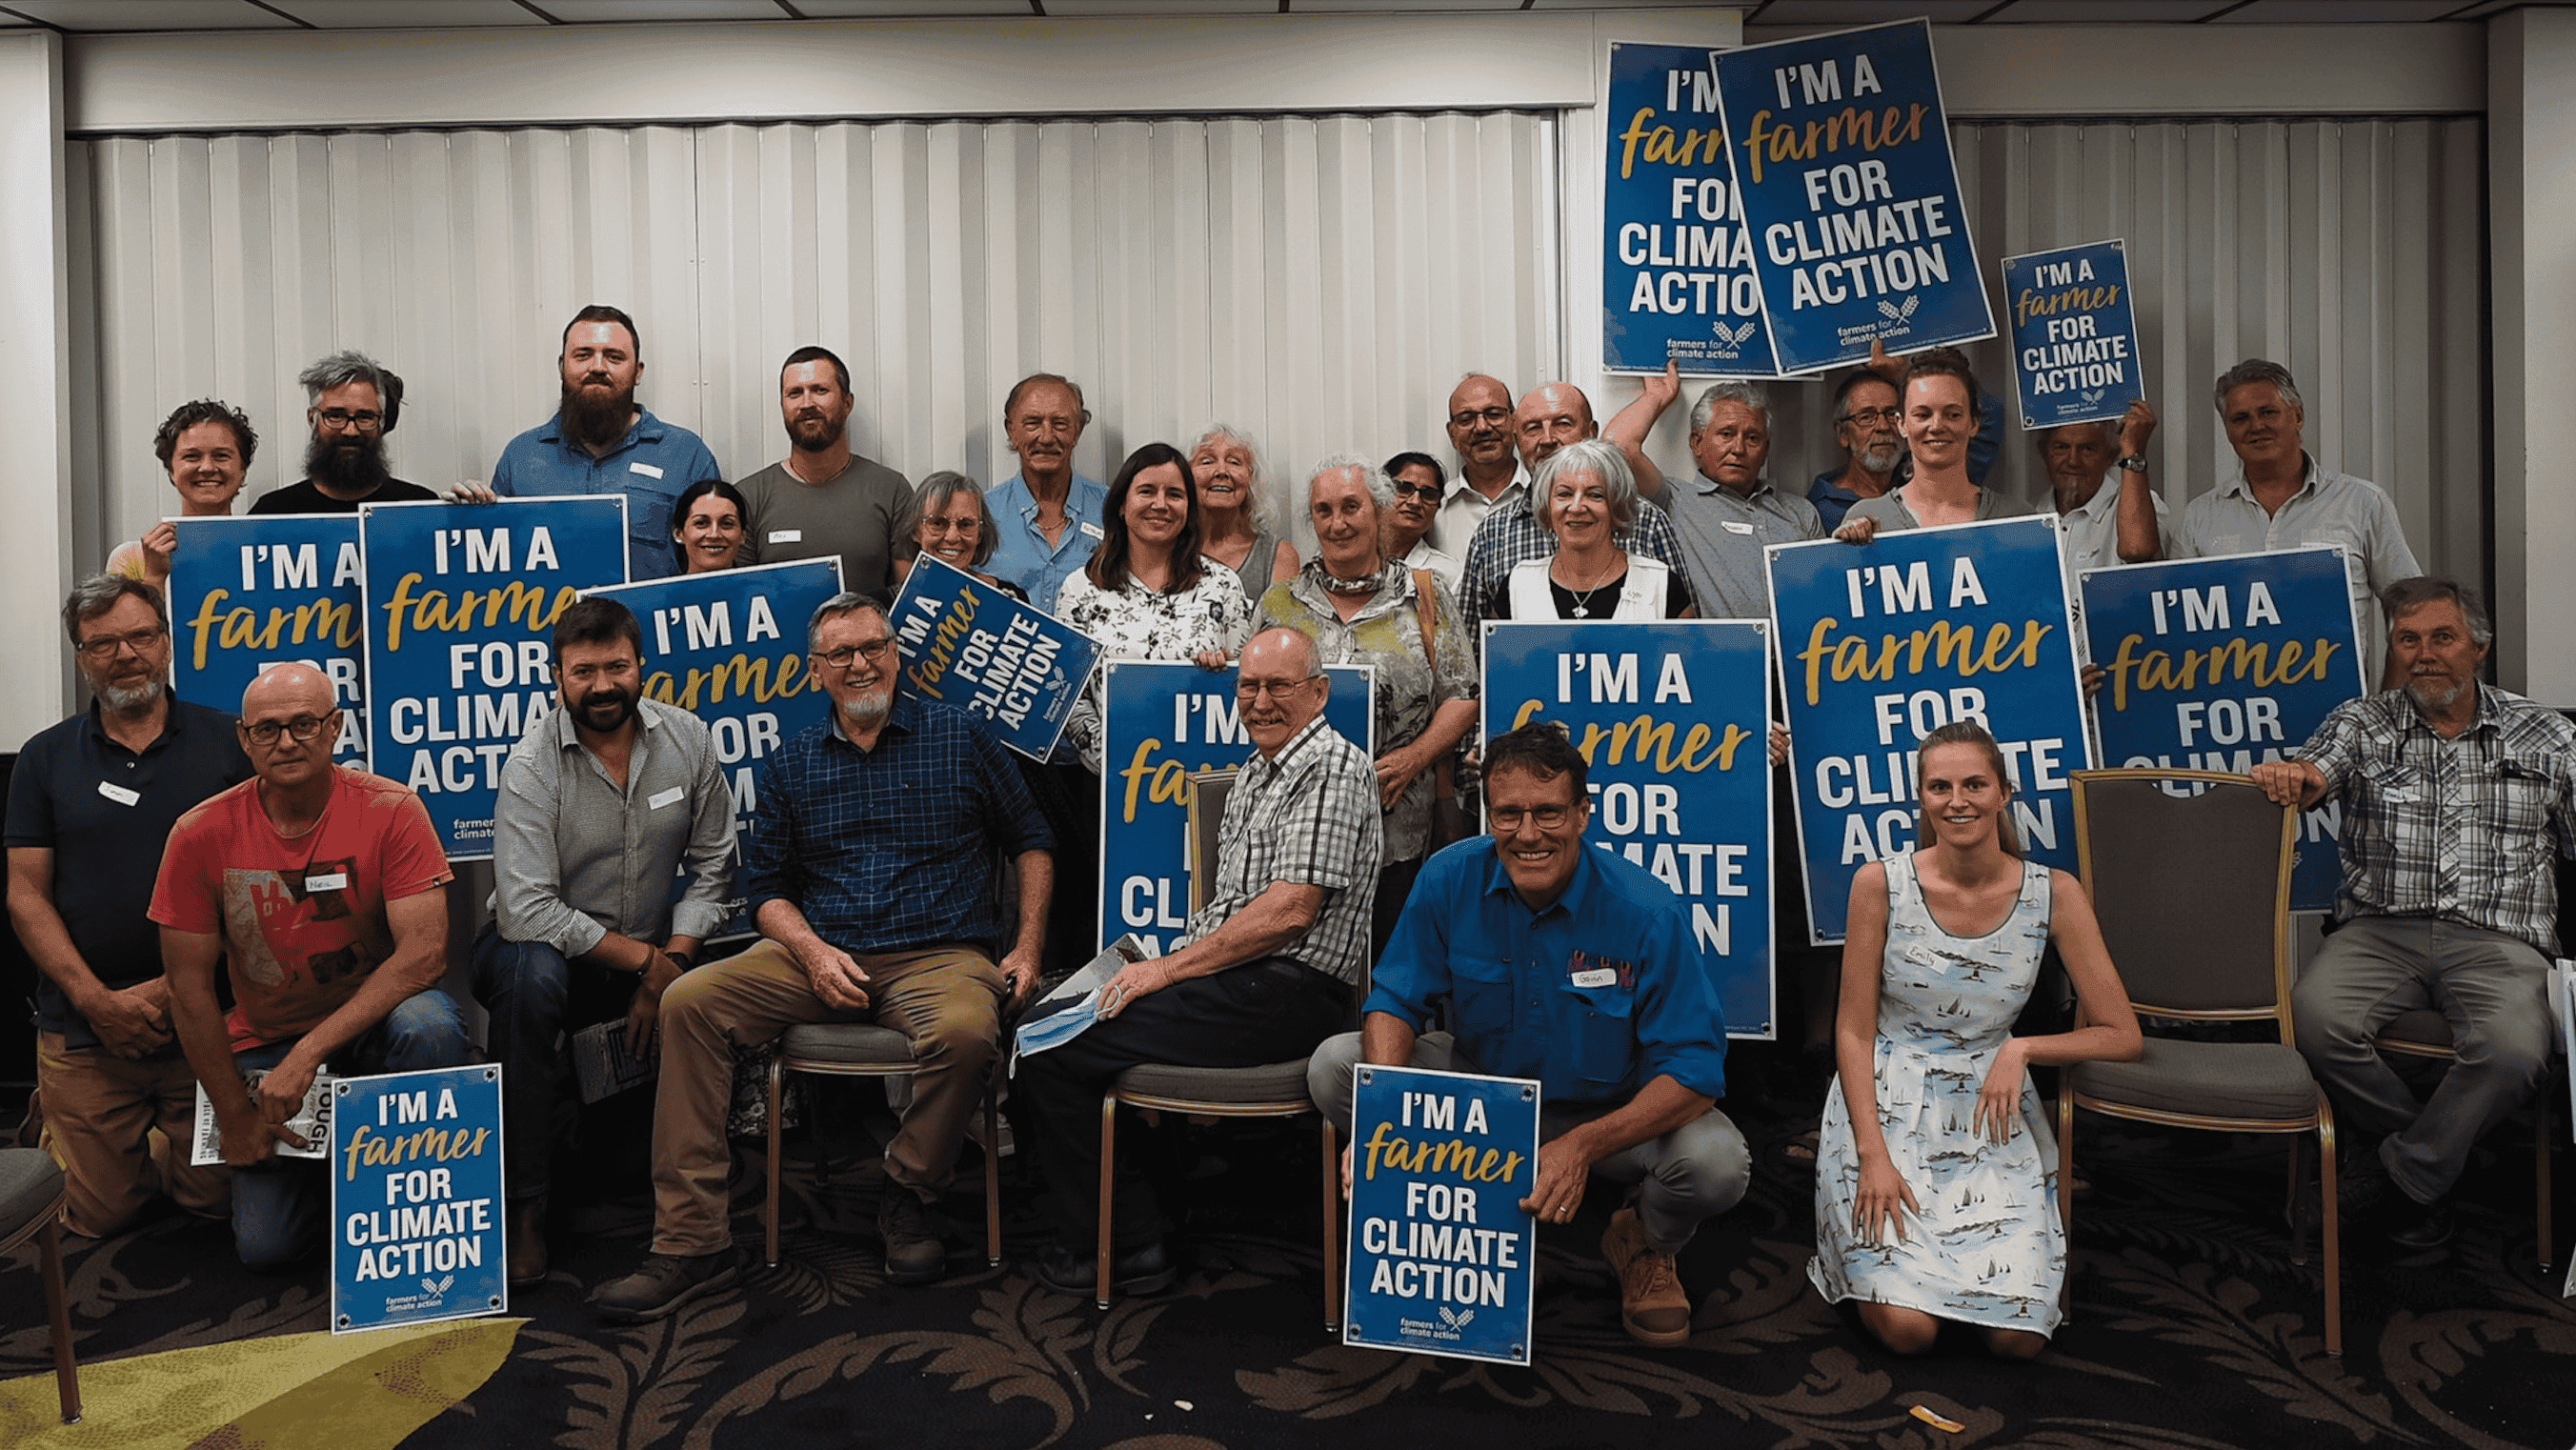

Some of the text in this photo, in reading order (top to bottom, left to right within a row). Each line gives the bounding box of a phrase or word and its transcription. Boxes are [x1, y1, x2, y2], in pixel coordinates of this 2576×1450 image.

[1775, 53, 1882, 110] I'M A
[1620, 107, 1726, 179] far
[1742, 103, 1929, 184] farmer
[1803, 159, 1893, 211] FOR
[1619, 222, 1752, 268] CLIMA
[1765, 195, 1952, 266] CLIMATE
[1629, 272, 1759, 316] ACTIO
[1792, 243, 1949, 311] ACTION
[2035, 258, 2095, 289] I'M A
[1838, 319, 1893, 337] farmers for
[2016, 285, 2121, 328] farmer
[2047, 314, 2096, 343] FOR
[1667, 338, 1722, 350] farmers for
[1667, 349, 1739, 359] climate action
[1879, 325, 1911, 340] action
[2023, 334, 2128, 372] CLIMATE
[2034, 361, 2123, 395] ACTION
[241, 542, 362, 591] I'M A
[434, 526, 559, 574] I'M A
[382, 572, 576, 652] farme
[1846, 556, 1987, 618] I'M A
[2151, 581, 2281, 635] I'M A
[186, 588, 363, 671] farm
[654, 595, 780, 655] I'M A
[896, 595, 943, 659] I'M A
[907, 584, 980, 699] farmer
[450, 640, 552, 690] FOR
[954, 628, 999, 683] FOR
[1558, 653, 1692, 703] I'M A
[1796, 616, 2053, 706] farmer
[2106, 634, 2342, 712] farmer
[640, 654, 822, 711] arme
[997, 633, 1062, 732] ACTION
[390, 691, 558, 745] CLIMA
[711, 713, 781, 764] OR
[1175, 694, 1250, 745] I'M
[1512, 699, 1752, 774] rmer
[1874, 687, 1991, 747] FOR
[2177, 696, 2284, 748] FOR
[408, 743, 515, 794] ACT
[1816, 738, 2069, 809] CLITE
[453, 818, 494, 829] farmer
[378, 1089, 458, 1126] I'M A
[1401, 1091, 1489, 1135] I'M A
[344, 1124, 492, 1182] farmer
[1363, 1121, 1525, 1183] farmer
[386, 1168, 453, 1206] FOR
[1406, 1181, 1478, 1224] FOR
[346, 1198, 492, 1247] CLIMATE
[1362, 1218, 1519, 1269] CLIMATE
[355, 1235, 481, 1282] ACTION
[1370, 1259, 1505, 1308] ACTION
[385, 1293, 430, 1305] farmers for
[385, 1299, 442, 1313] climate action
[1400, 1317, 1447, 1330] farmers for
[1399, 1325, 1460, 1340] climate action
